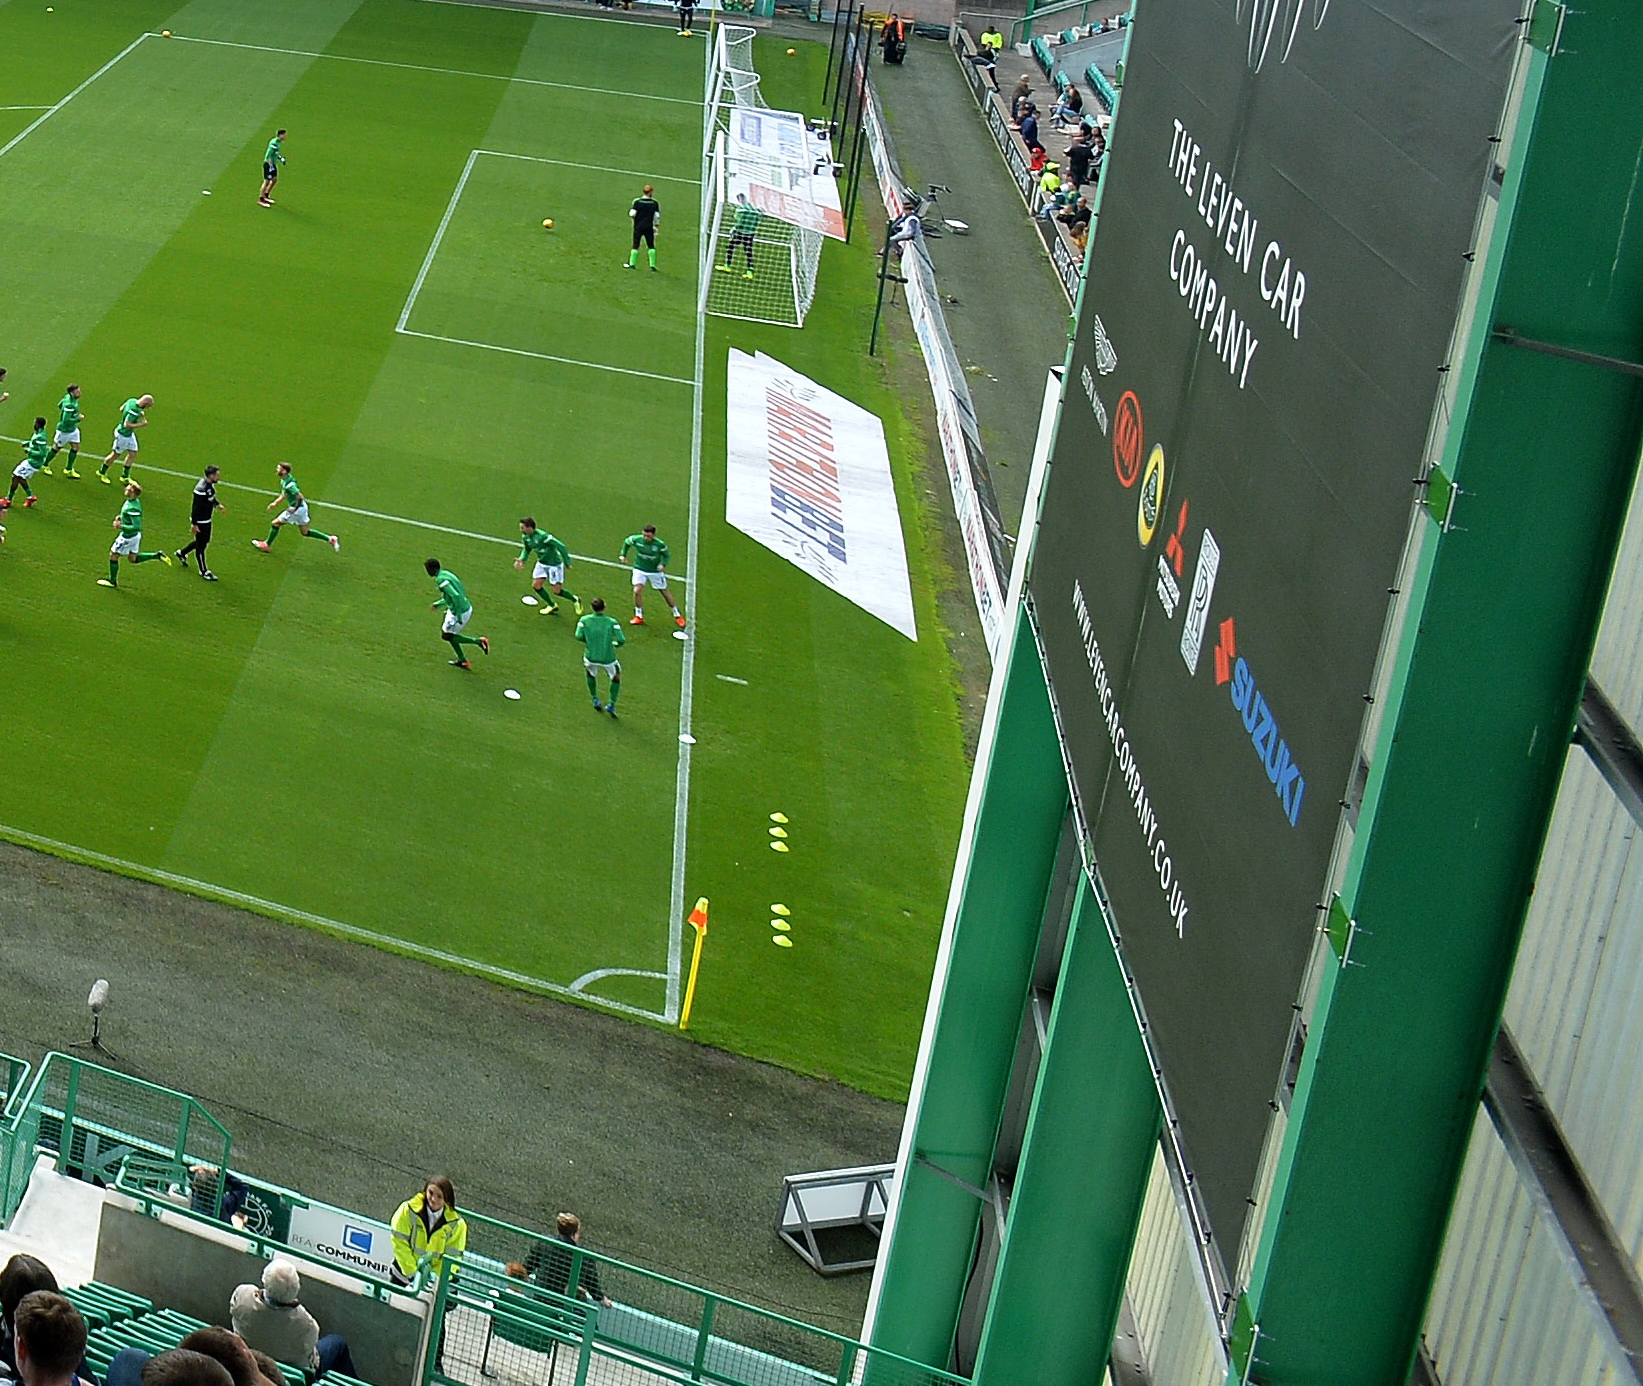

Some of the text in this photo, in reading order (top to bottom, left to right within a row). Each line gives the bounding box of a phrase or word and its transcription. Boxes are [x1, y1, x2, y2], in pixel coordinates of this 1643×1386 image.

[1169, 118, 1306, 339] THE LEVEN CAR
[1170, 229, 1258, 389] COMPANY
[765, 387, 847, 565] MARATHONBET
[1073, 579, 1189, 938] WWW.LEVENCARCOMPANY.CO.UK
[1231, 657, 1306, 827] SUZUKI
